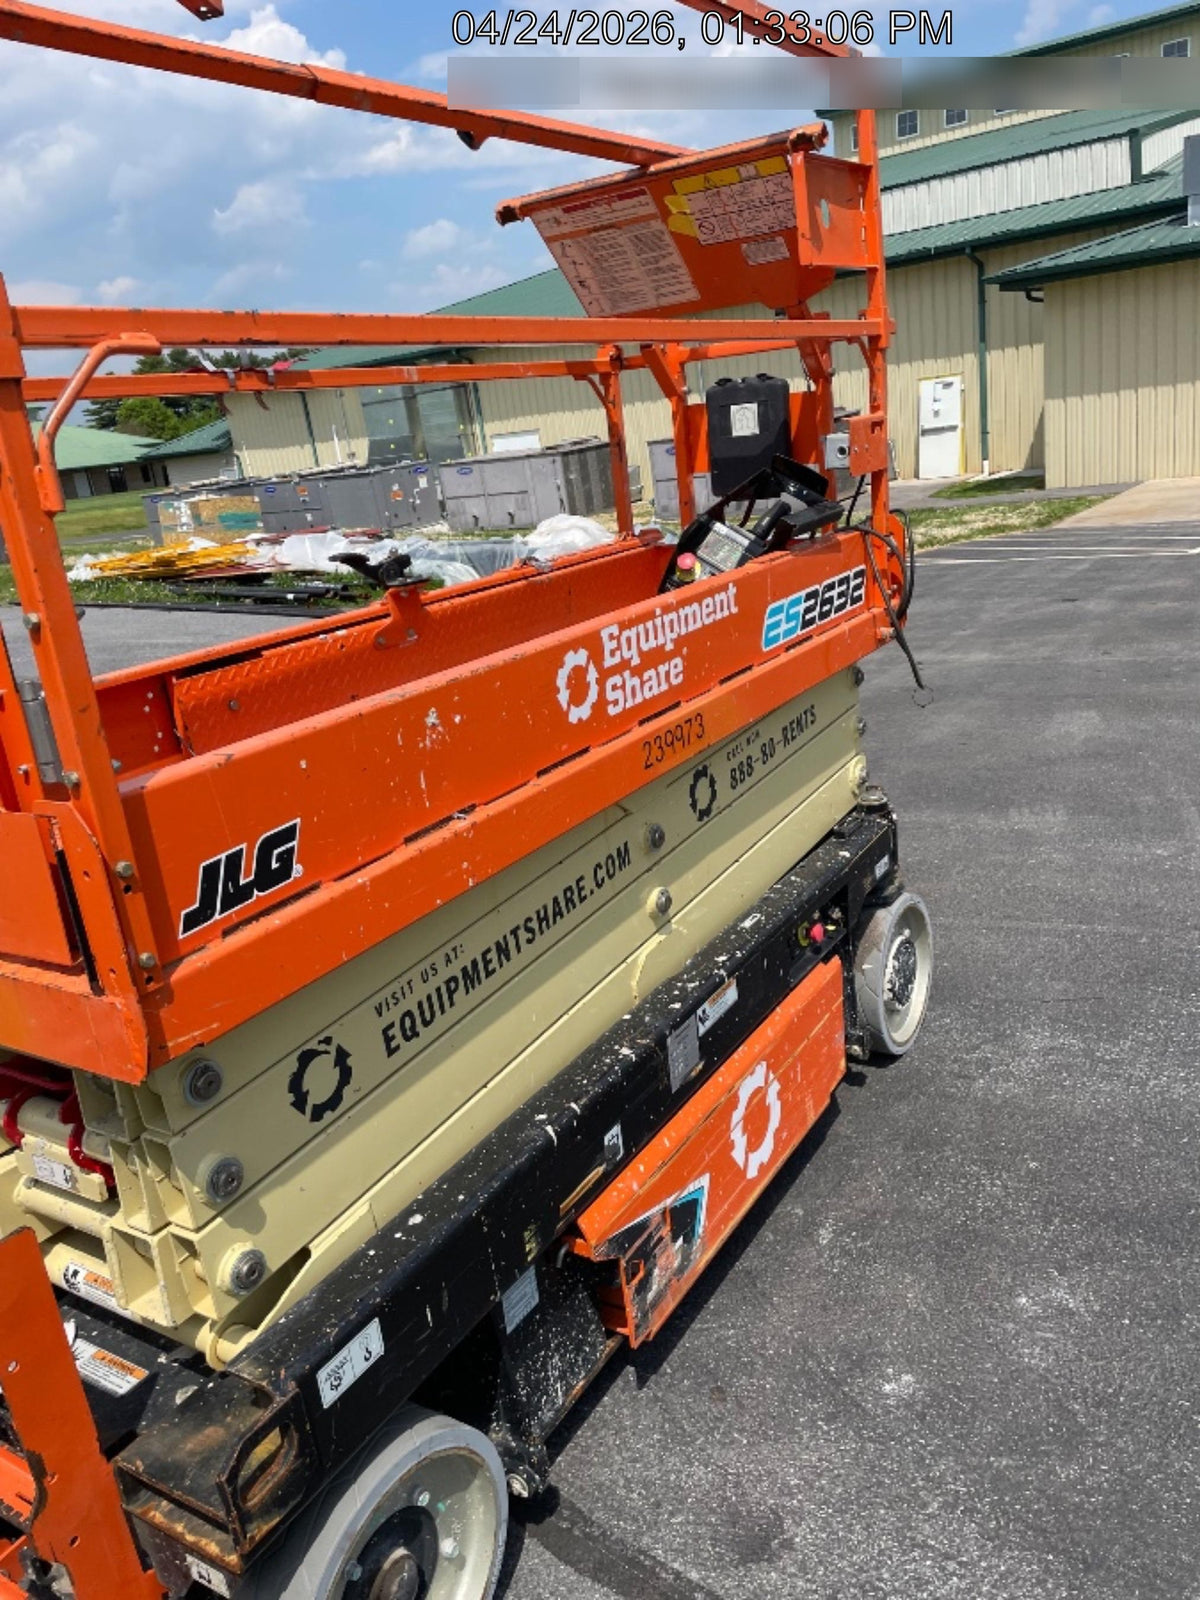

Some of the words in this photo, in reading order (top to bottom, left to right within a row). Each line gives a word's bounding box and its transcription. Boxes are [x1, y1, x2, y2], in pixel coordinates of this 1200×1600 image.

[600, 582, 739, 669] Equipment
[762, 564, 867, 652] ES2632
[605, 654, 684, 717] Share
[642, 712, 706, 770] 239973
[730, 704, 817, 791] 888-80-RENTS
[179, 818, 301, 939] JLG
[373, 979, 415, 1019] VISIT
[420, 962, 439, 985] US
[444, 943, 466, 967] AT:
[381, 840, 633, 1059] EQUIPMENTSHARE.COM
